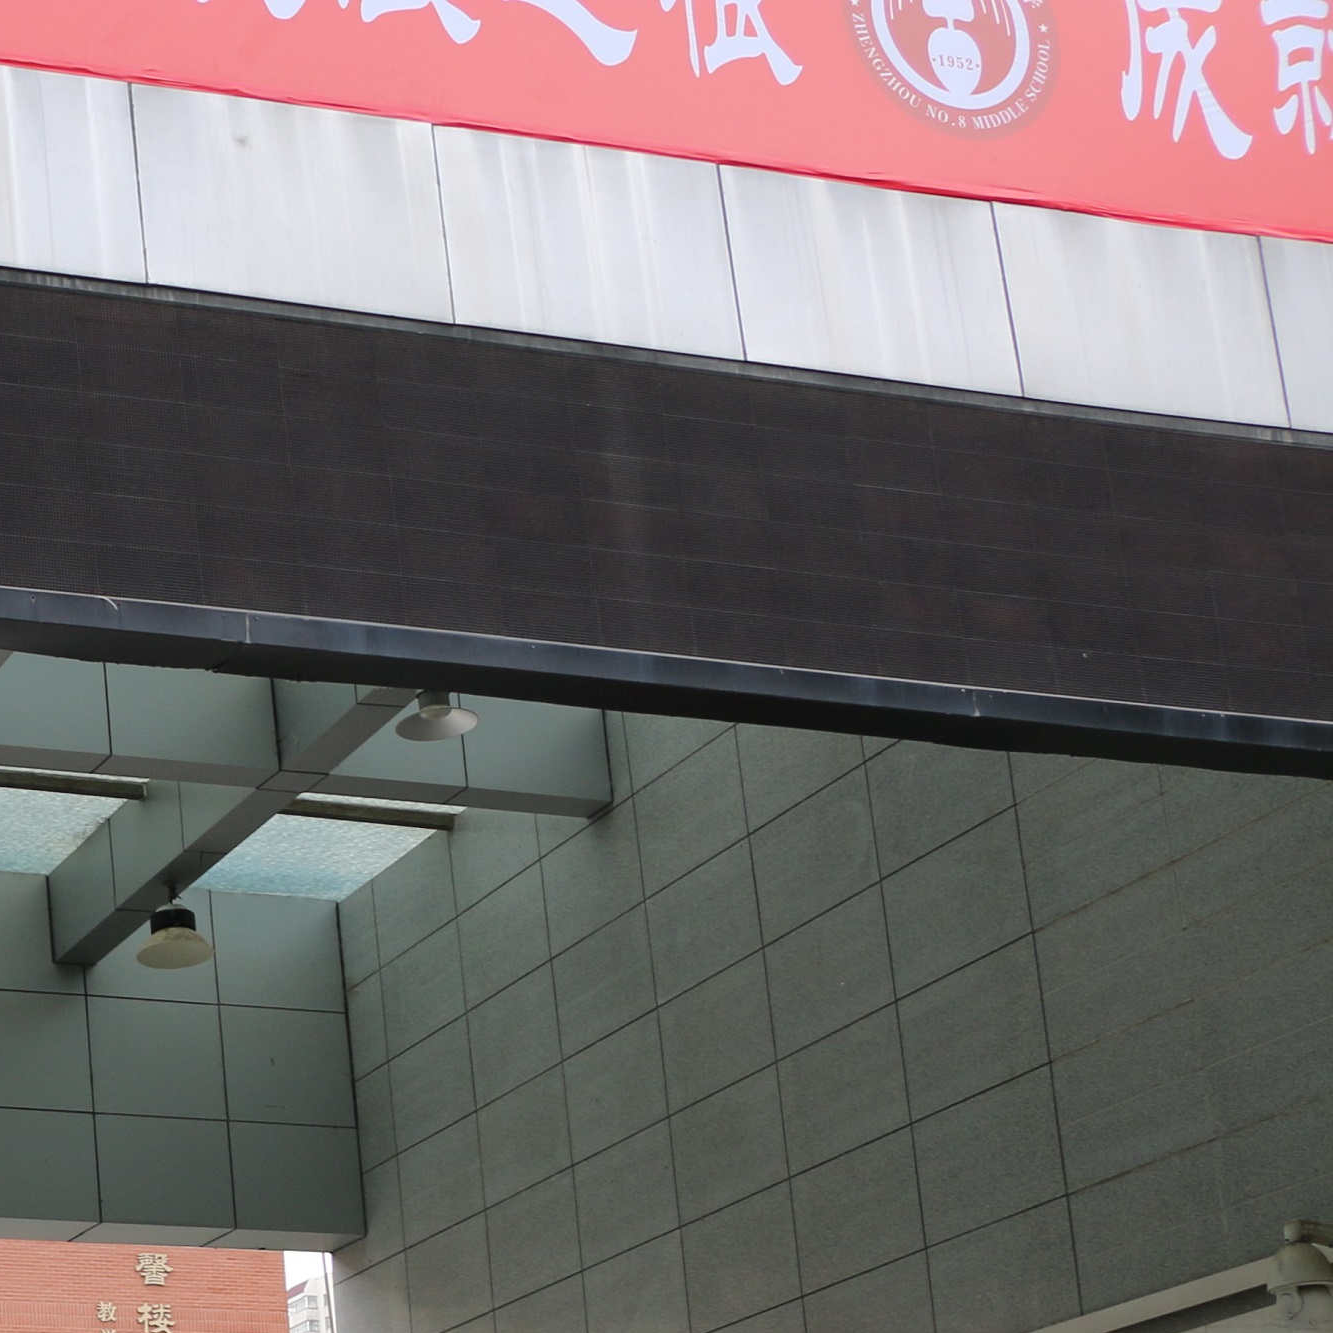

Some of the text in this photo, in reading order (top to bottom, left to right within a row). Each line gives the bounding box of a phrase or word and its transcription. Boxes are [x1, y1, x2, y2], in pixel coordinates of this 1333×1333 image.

[851, 12, 922, 109] ZHENGZHOU
[971, 97, 1029, 130] MIDDLE
[1024, 39, 1051, 103] SCHOOL
